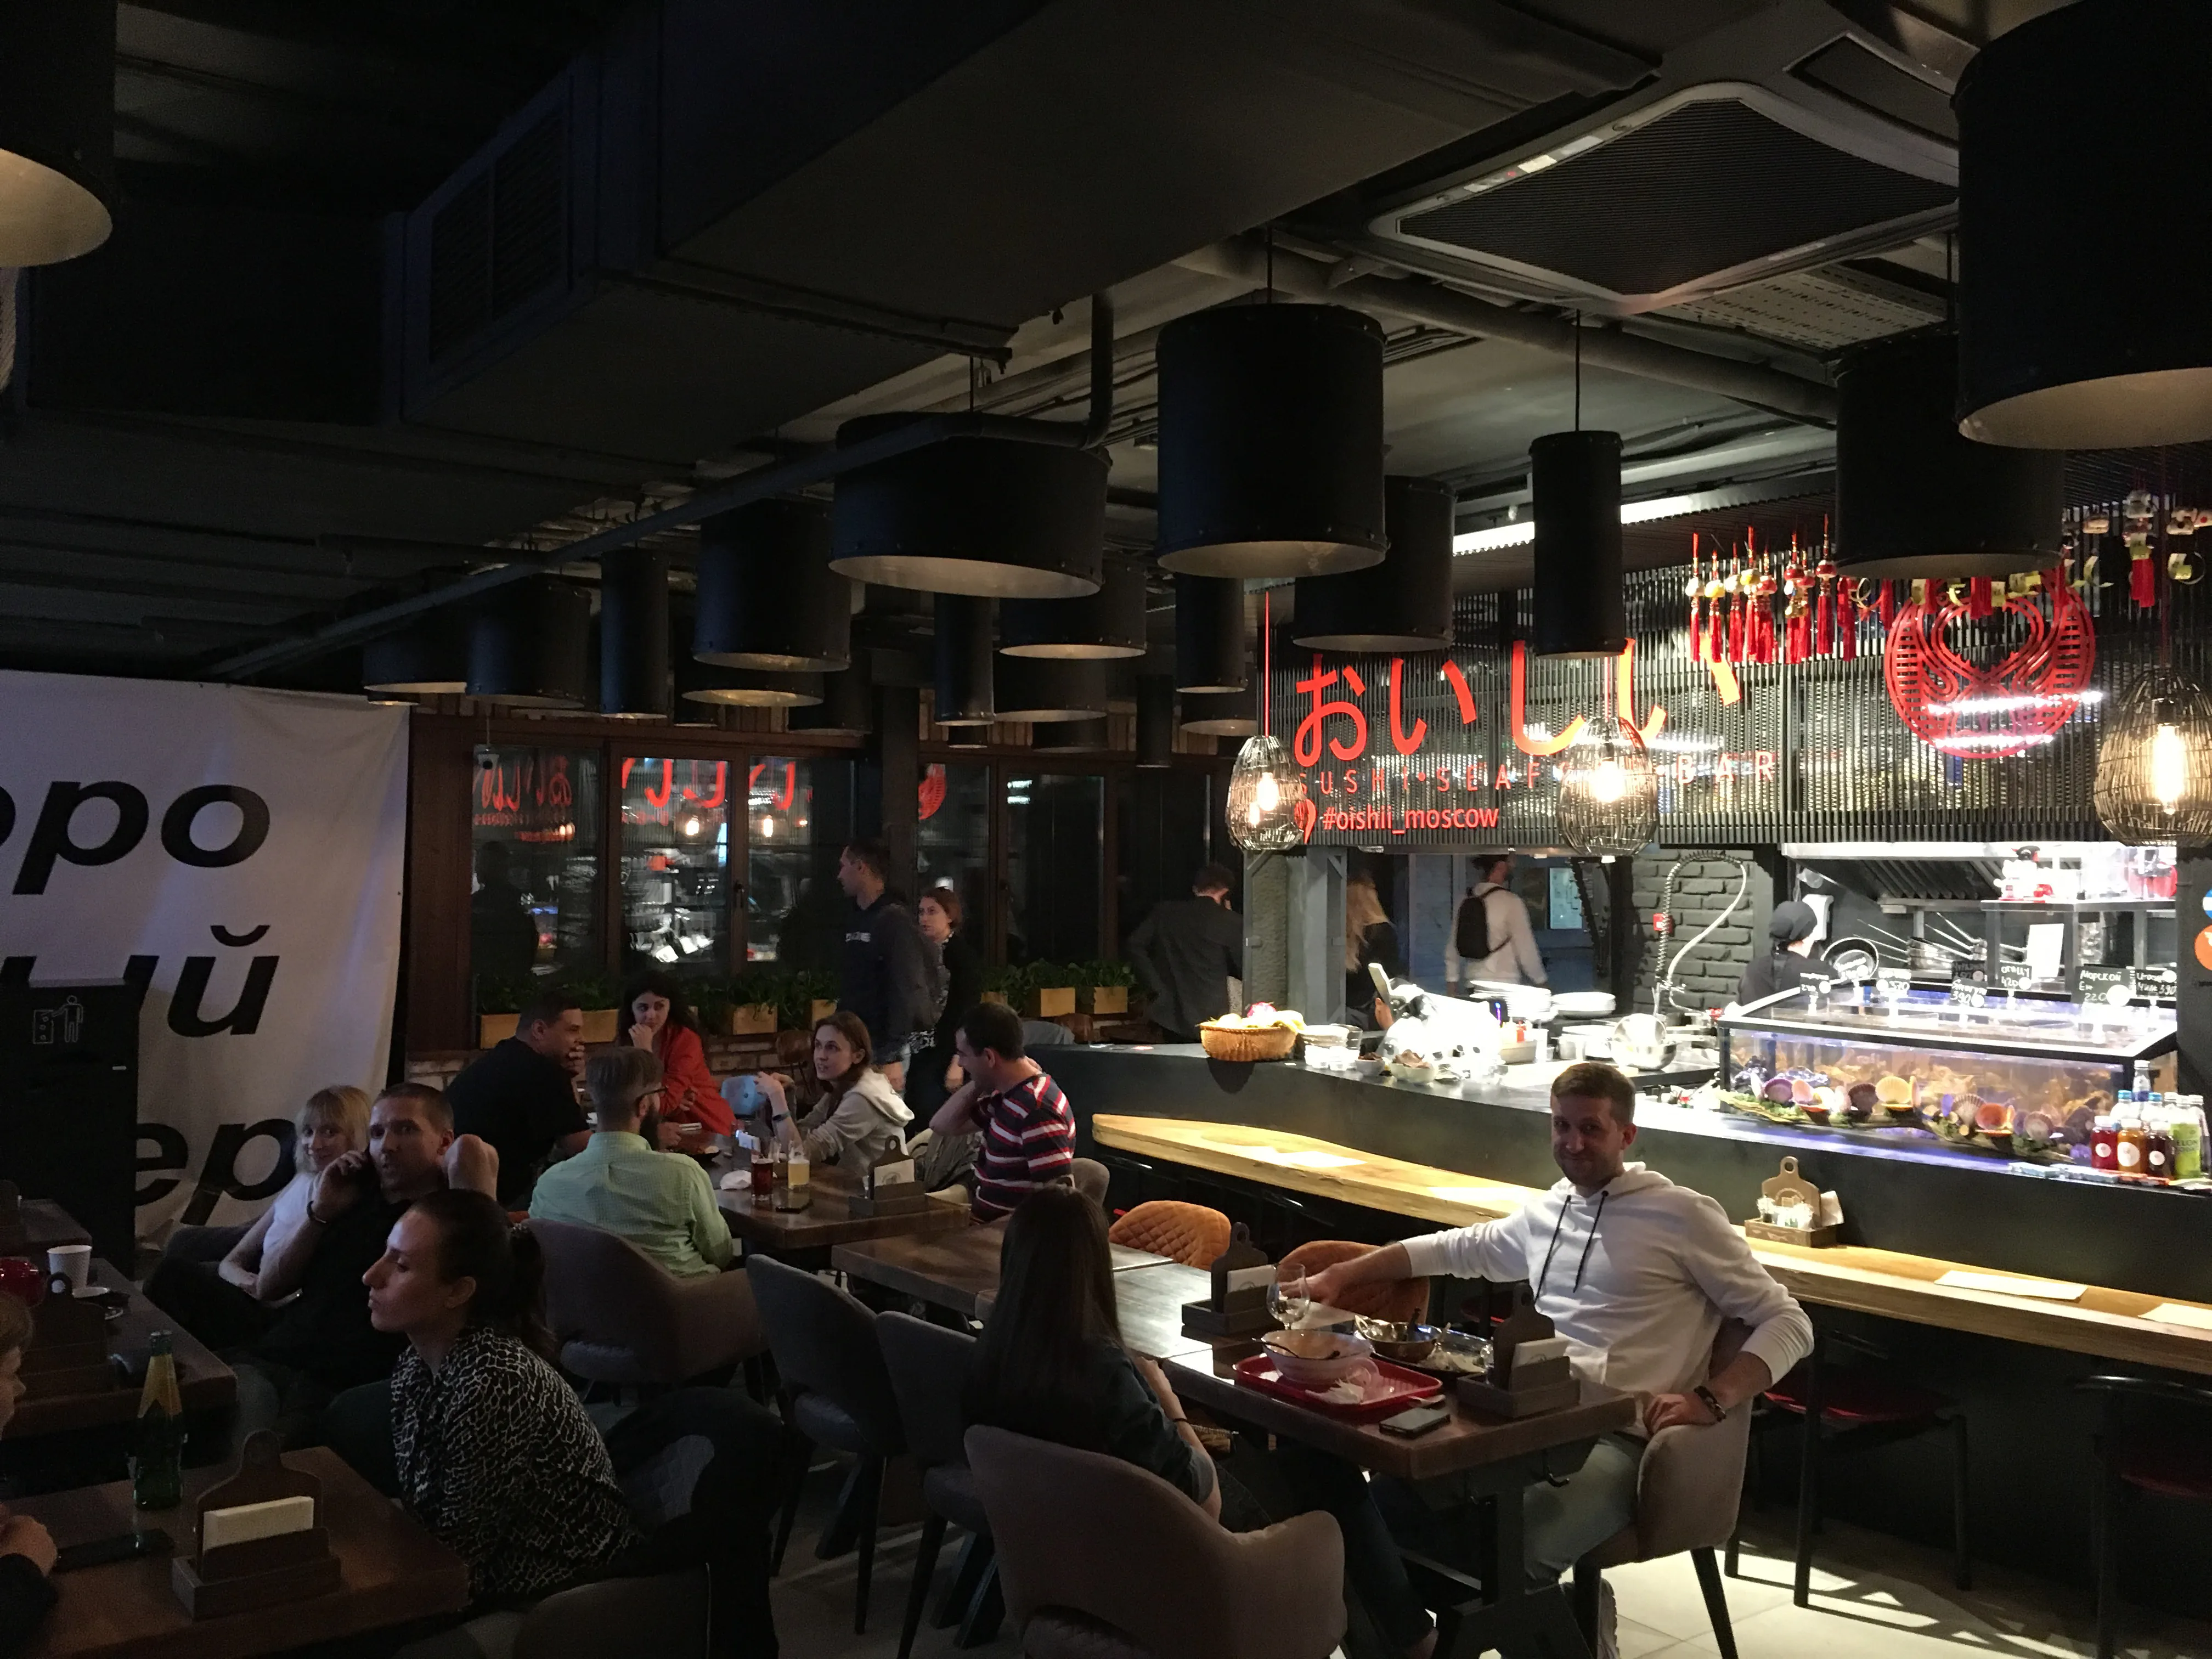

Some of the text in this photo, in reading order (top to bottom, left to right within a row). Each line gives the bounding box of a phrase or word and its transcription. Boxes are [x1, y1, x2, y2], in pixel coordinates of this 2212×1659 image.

[1677, 751, 1775, 785] BAR
[1322, 804, 1499, 835] #oishii_moscow
[0, 780, 270, 895] ро
[2001, 976, 2018, 987] 420
[1950, 990, 1971, 1005] 390
[2084, 992, 2107, 1001] 220
